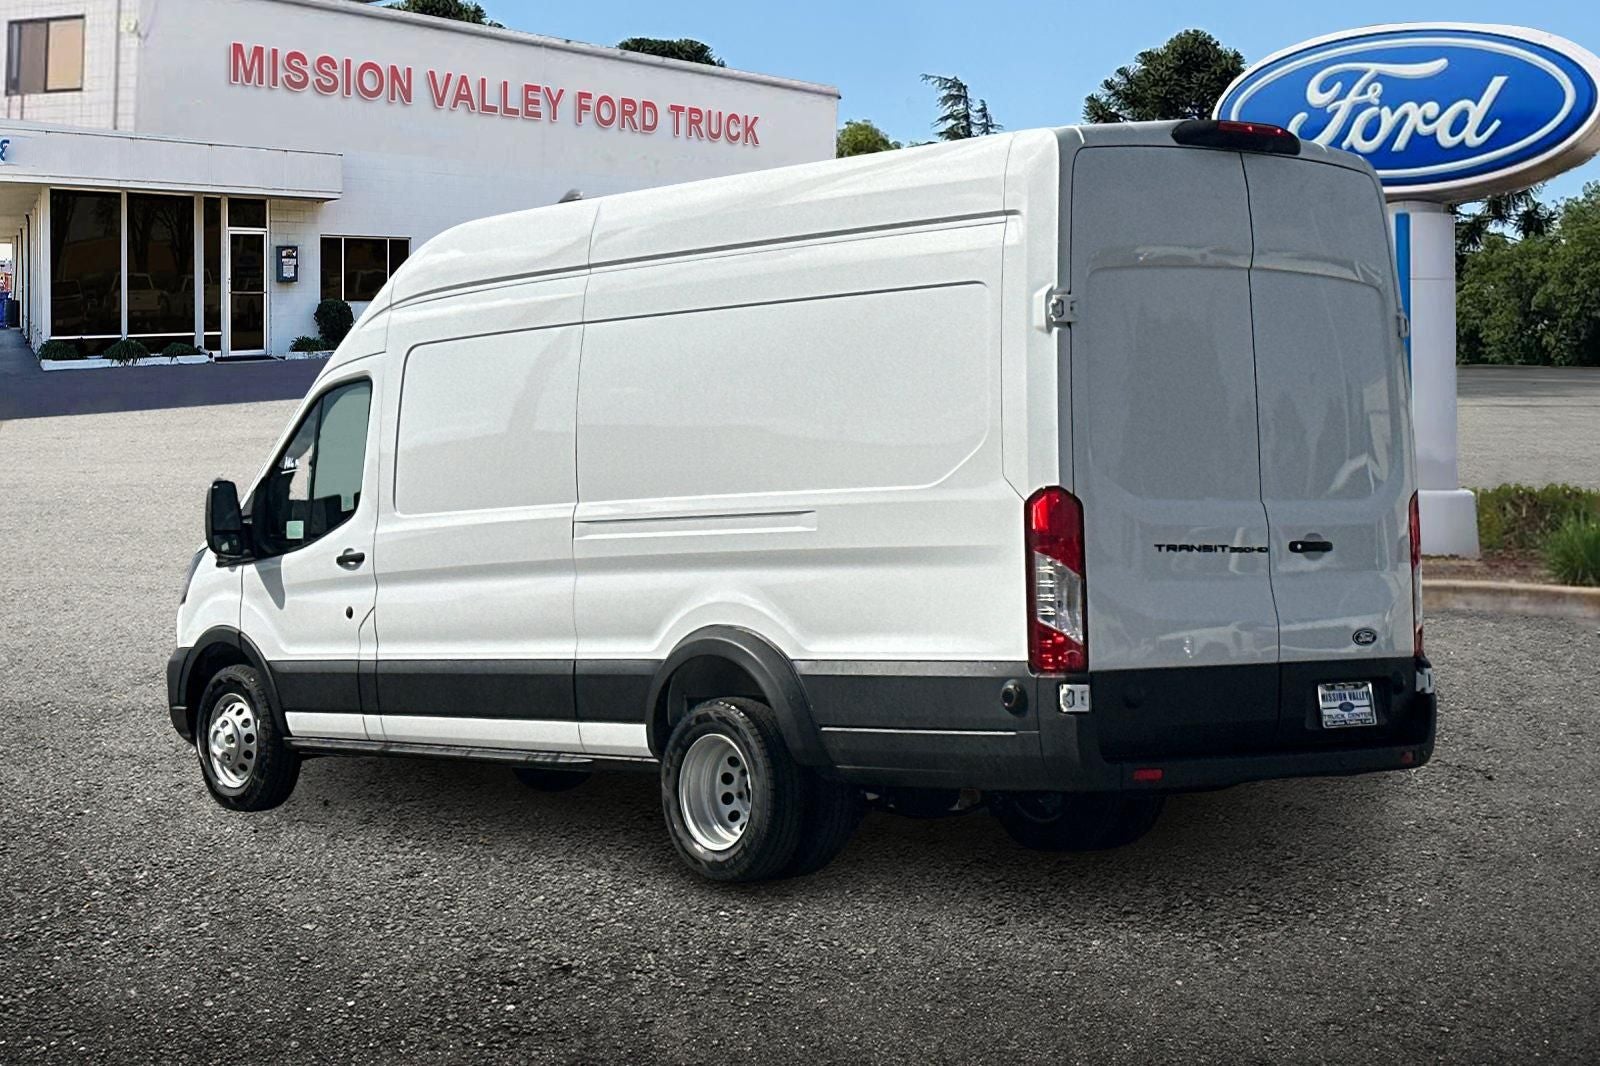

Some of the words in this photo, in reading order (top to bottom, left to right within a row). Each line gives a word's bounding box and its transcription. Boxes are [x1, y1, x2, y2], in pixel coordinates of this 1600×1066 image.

[229, 41, 413, 105] MISSION
[427, 69, 565, 122] VALLEY
[575, 90, 660, 134] FORD
[668, 104, 760, 146] TRUCK
[1288, 57, 1509, 152] Ford
[1154, 544, 1229, 552] TRANSIT
